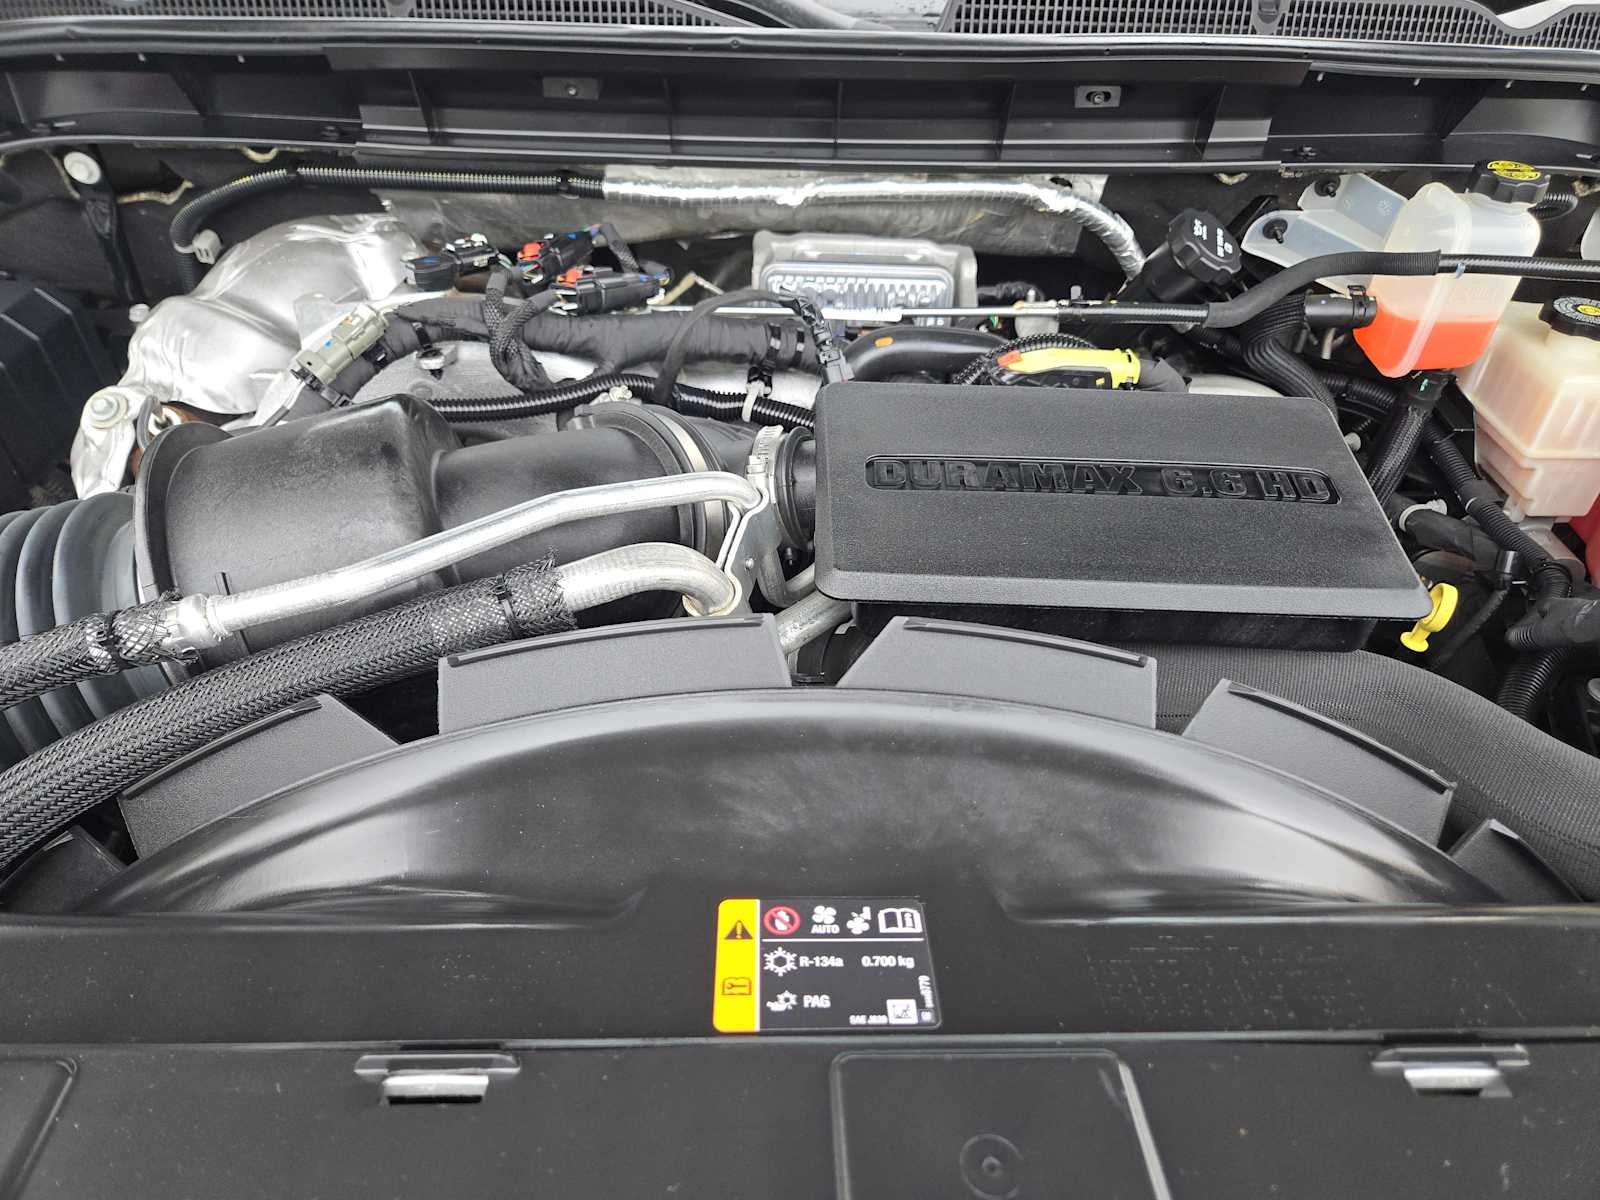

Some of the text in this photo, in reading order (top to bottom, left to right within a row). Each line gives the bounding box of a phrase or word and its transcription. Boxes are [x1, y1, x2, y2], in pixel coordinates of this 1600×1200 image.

[873, 459, 1330, 503] DURAMAX 6.6 HD
[811, 924, 840, 934] AUTO
[799, 956, 915, 969] R-134a 0.700 kg
[803, 994, 831, 1009] PAG
